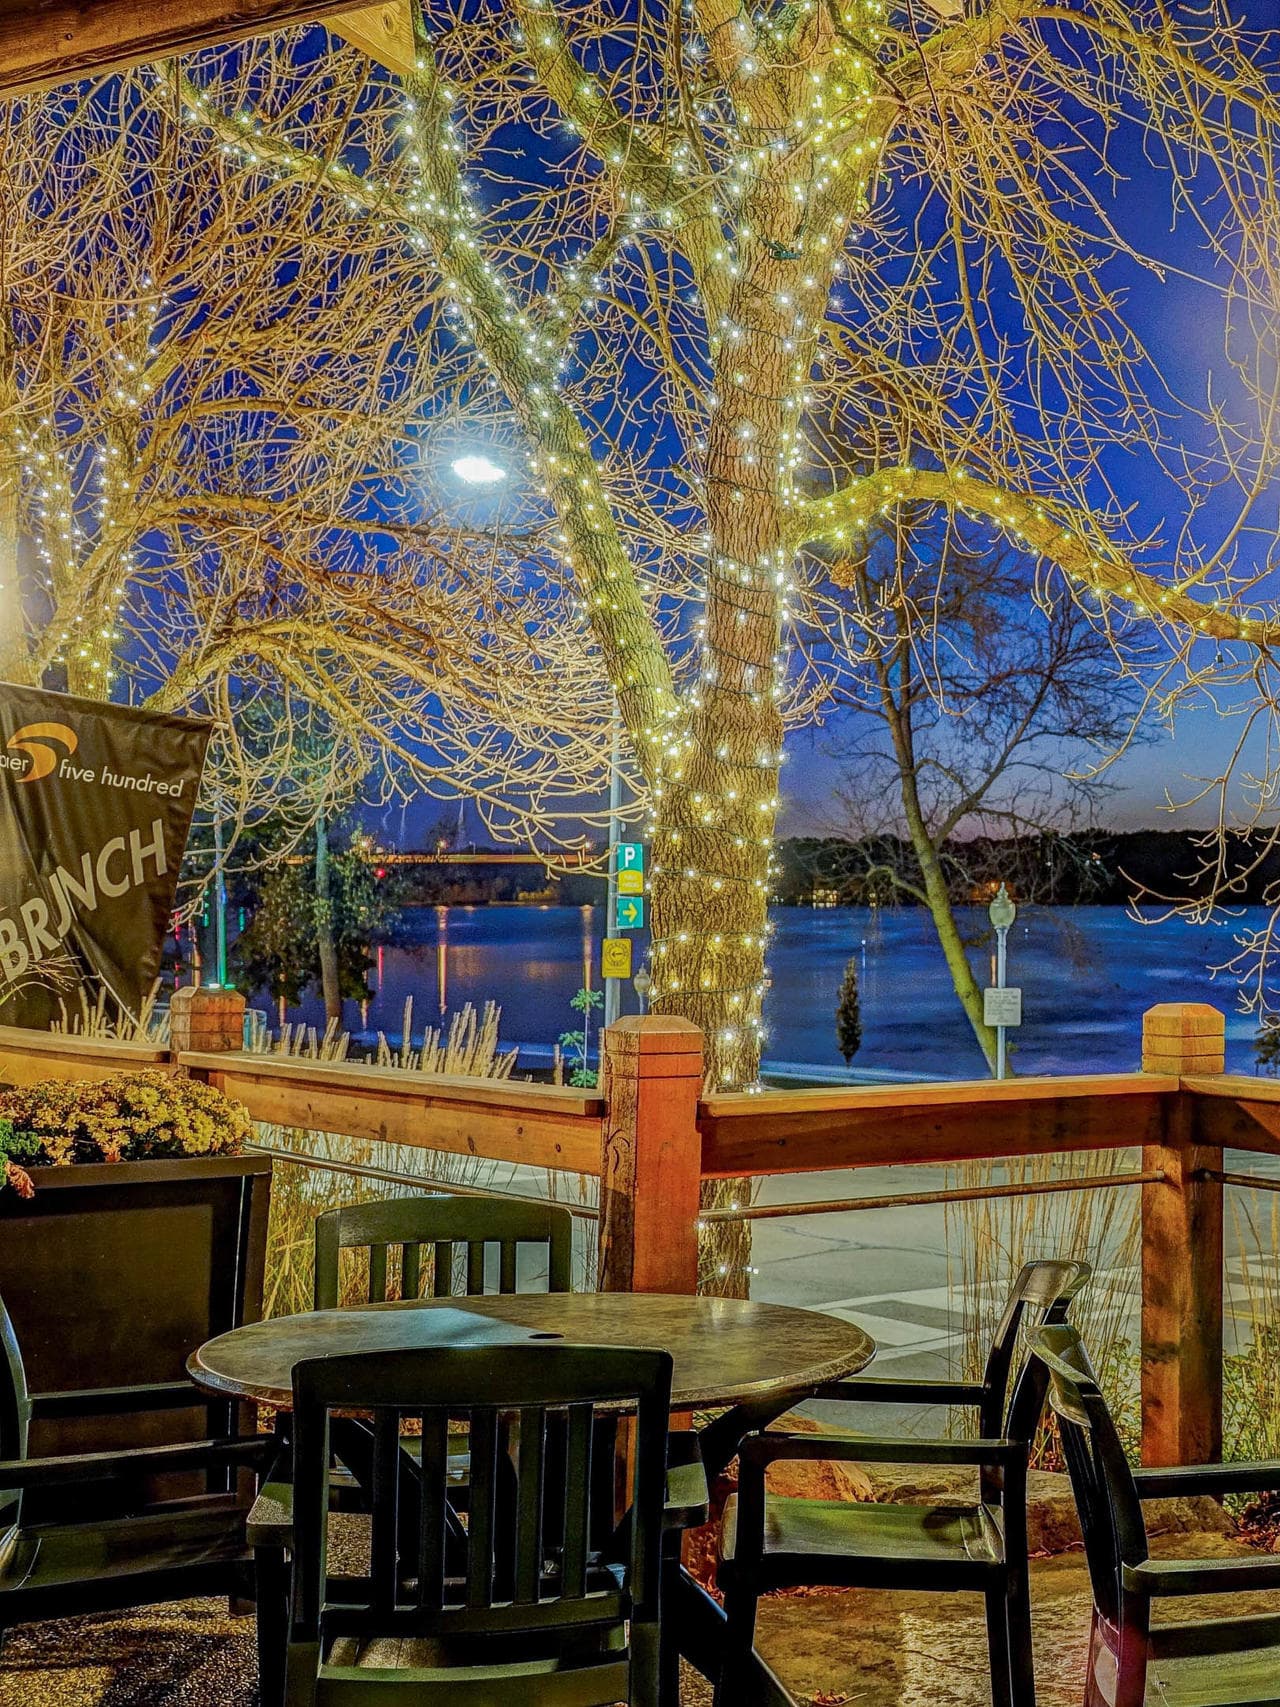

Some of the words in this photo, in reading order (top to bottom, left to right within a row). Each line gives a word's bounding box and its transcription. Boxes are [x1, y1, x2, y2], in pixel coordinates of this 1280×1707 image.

[58, 759, 96, 783] five
[101, 766, 184, 797] hundred
[624, 846, 636, 868] P
